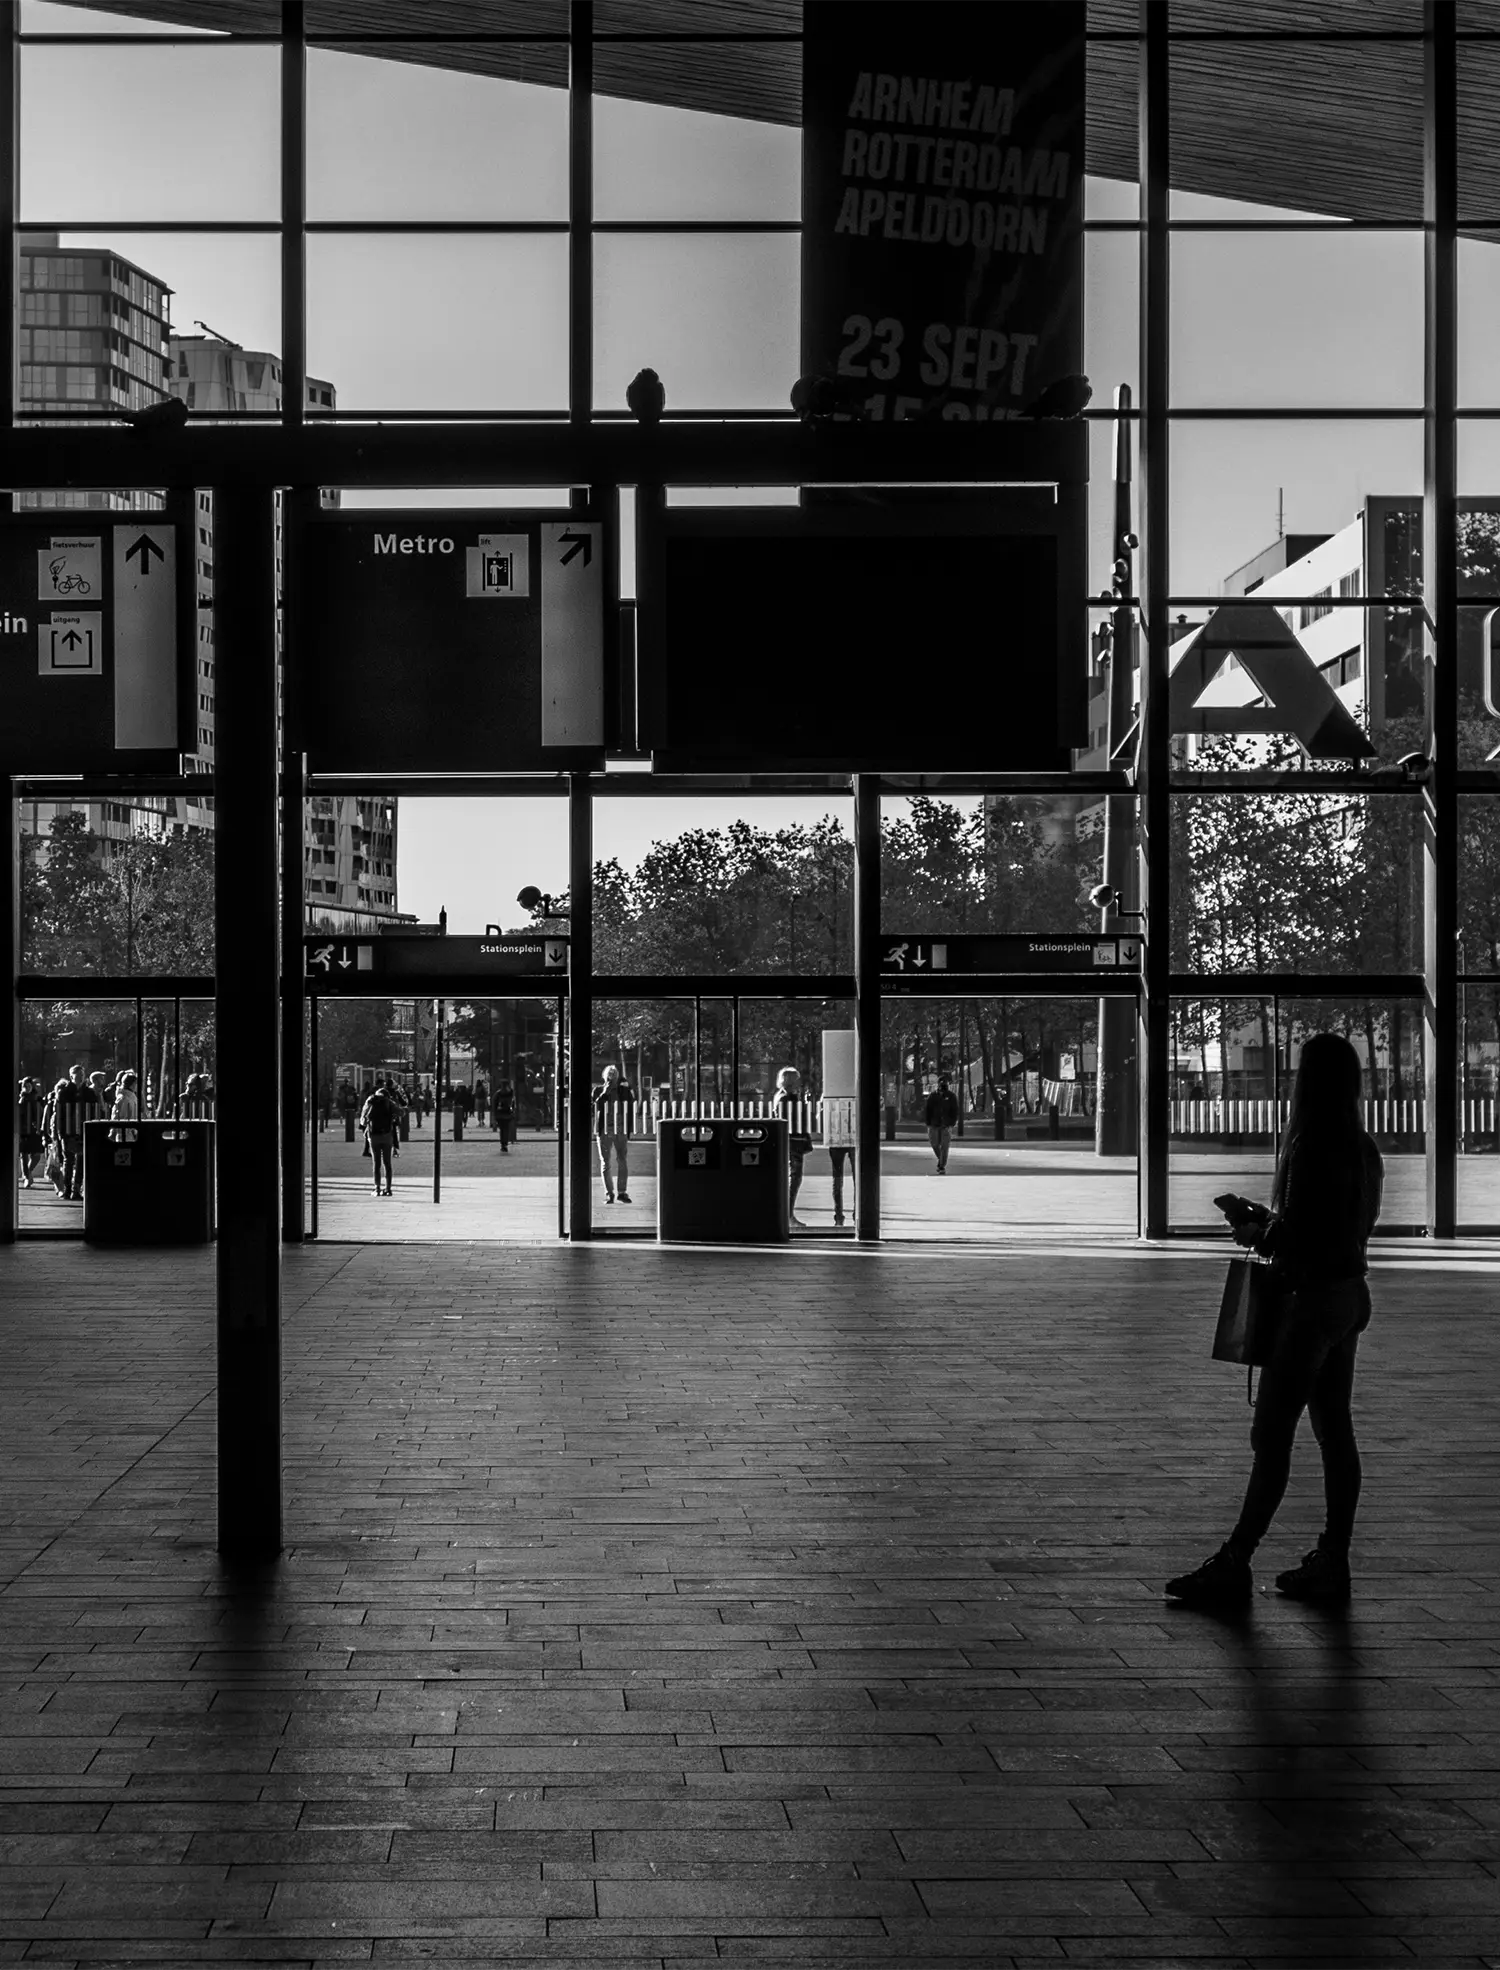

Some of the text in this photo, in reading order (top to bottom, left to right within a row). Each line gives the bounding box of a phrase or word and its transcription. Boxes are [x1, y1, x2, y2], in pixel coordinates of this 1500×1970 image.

[847, 70, 1016, 136] ARNHEM
[841, 128, 1072, 200] ROTTERDAM
[834, 186, 1049, 256] APELDOORN
[837, 313, 1039, 397] 23 SEPT
[52, 541, 96, 549] fietsverhuur
[373, 533, 455, 554] Metro
[0, 611, 28, 634] in
[53, 616, 81, 624] uitgang
[480, 944, 542, 954] Stationsplein
[1029, 942, 1091, 953] Stationsplein
